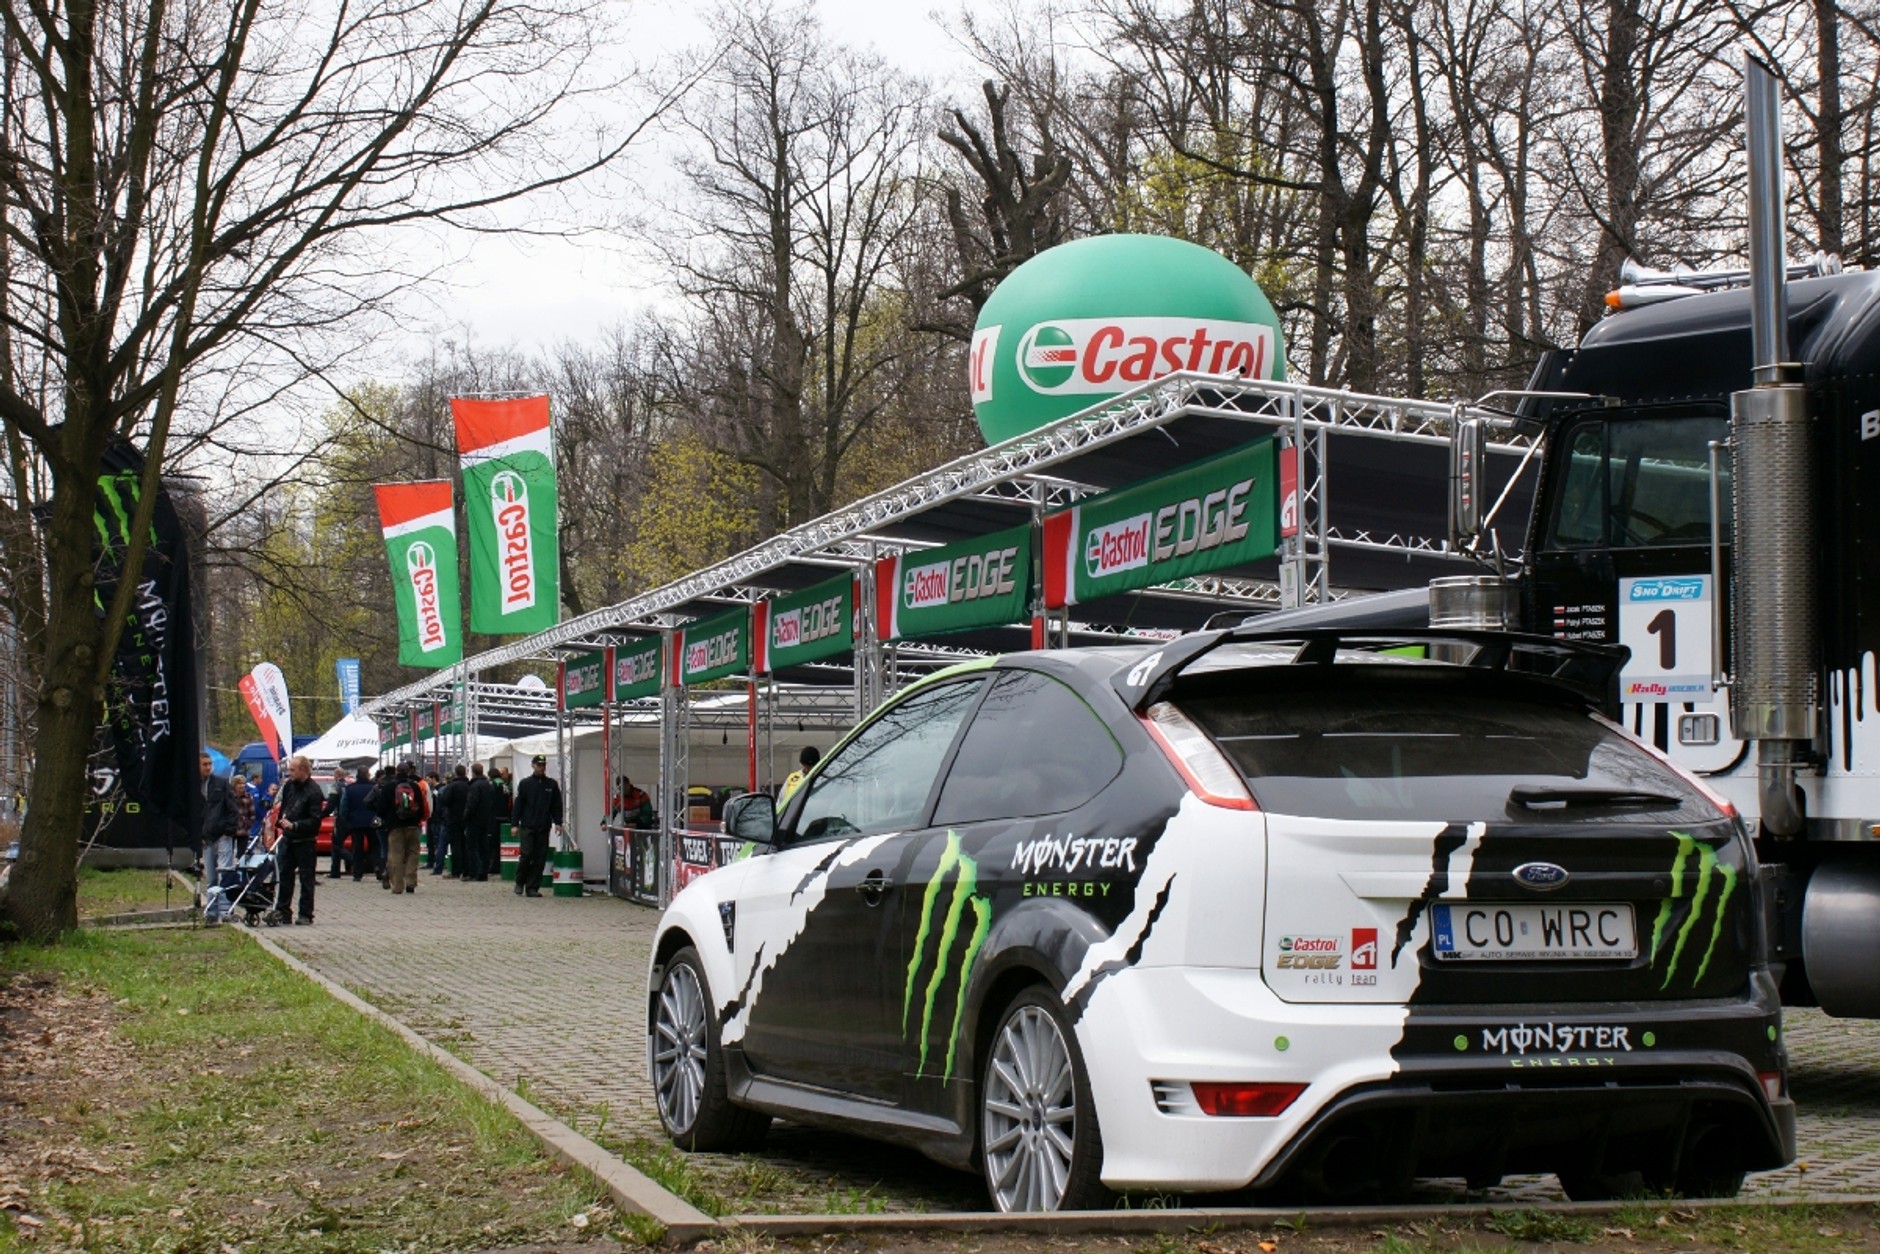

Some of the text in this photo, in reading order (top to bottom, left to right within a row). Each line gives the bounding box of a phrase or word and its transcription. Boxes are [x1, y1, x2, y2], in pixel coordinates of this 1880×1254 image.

[1082, 326, 1264, 384] Castrol
[1101, 477, 1255, 570] Castrol EDGE
[914, 546, 1019, 603] Castrol EDGE
[801, 595, 843, 643] EDGE
[709, 628, 739, 669] EDGE
[1646, 608, 1676, 671] 1
[1631, 684, 1667, 695] Rally
[1011, 832, 1138, 875] MONSTER
[1023, 882, 1111, 897] ENERGY
[1527, 866, 1557, 880] Ford
[1294, 937, 1338, 951] Castrol
[1438, 934, 1452, 945] PL
[1540, 909, 1620, 948] WRC
[1276, 954, 1342, 970] EDGE
[1304, 972, 1342, 985] rally
[1481, 1022, 1633, 1055] MONSTER
[1511, 1057, 1615, 1068] ENERGY
